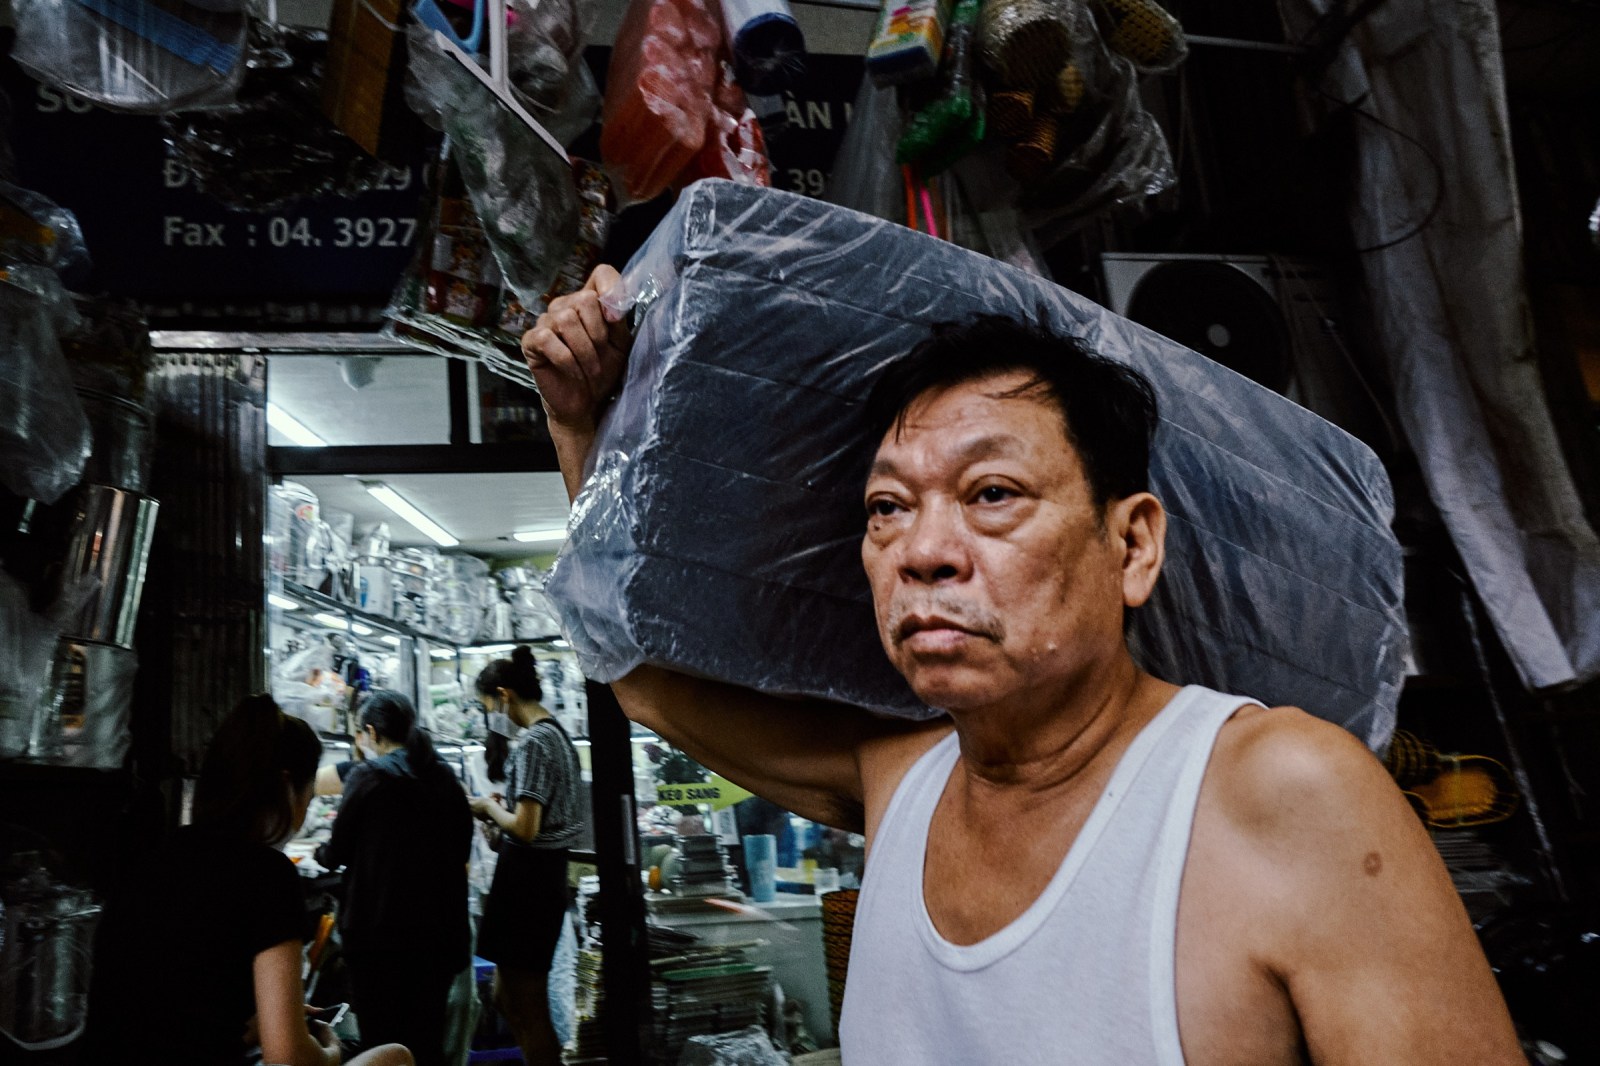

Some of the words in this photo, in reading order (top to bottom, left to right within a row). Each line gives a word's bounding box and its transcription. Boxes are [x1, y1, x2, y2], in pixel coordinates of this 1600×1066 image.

[787, 168, 832, 197] 39
[162, 216, 226, 247] Fax
[268, 216, 322, 247] 04.
[333, 216, 418, 248] 3927
[687, 788, 720, 800] SANG
